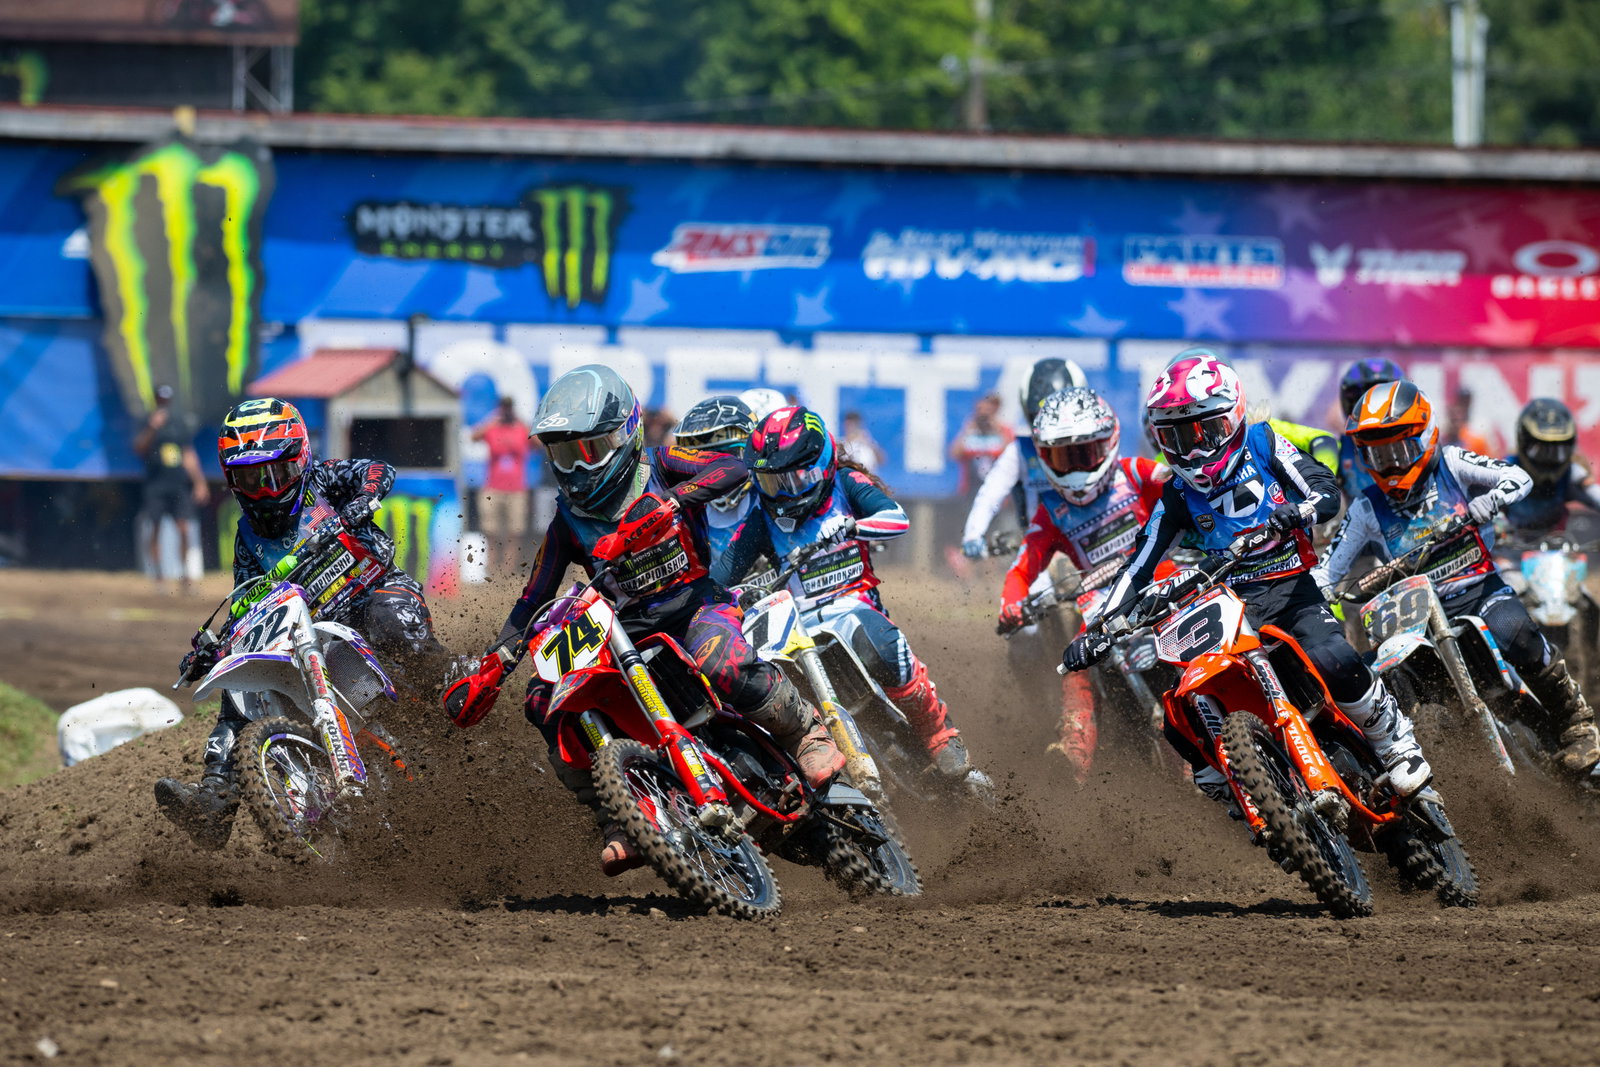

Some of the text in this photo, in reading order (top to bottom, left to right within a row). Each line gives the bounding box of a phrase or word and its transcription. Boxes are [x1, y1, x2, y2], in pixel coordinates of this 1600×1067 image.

[307, 553, 353, 598] AMPIONSHIP
[621, 553, 686, 591] CHAMPIONSHIP
[1177, 602, 1224, 662] 3
[1372, 588, 1429, 640] 69
[541, 611, 605, 677] 74
